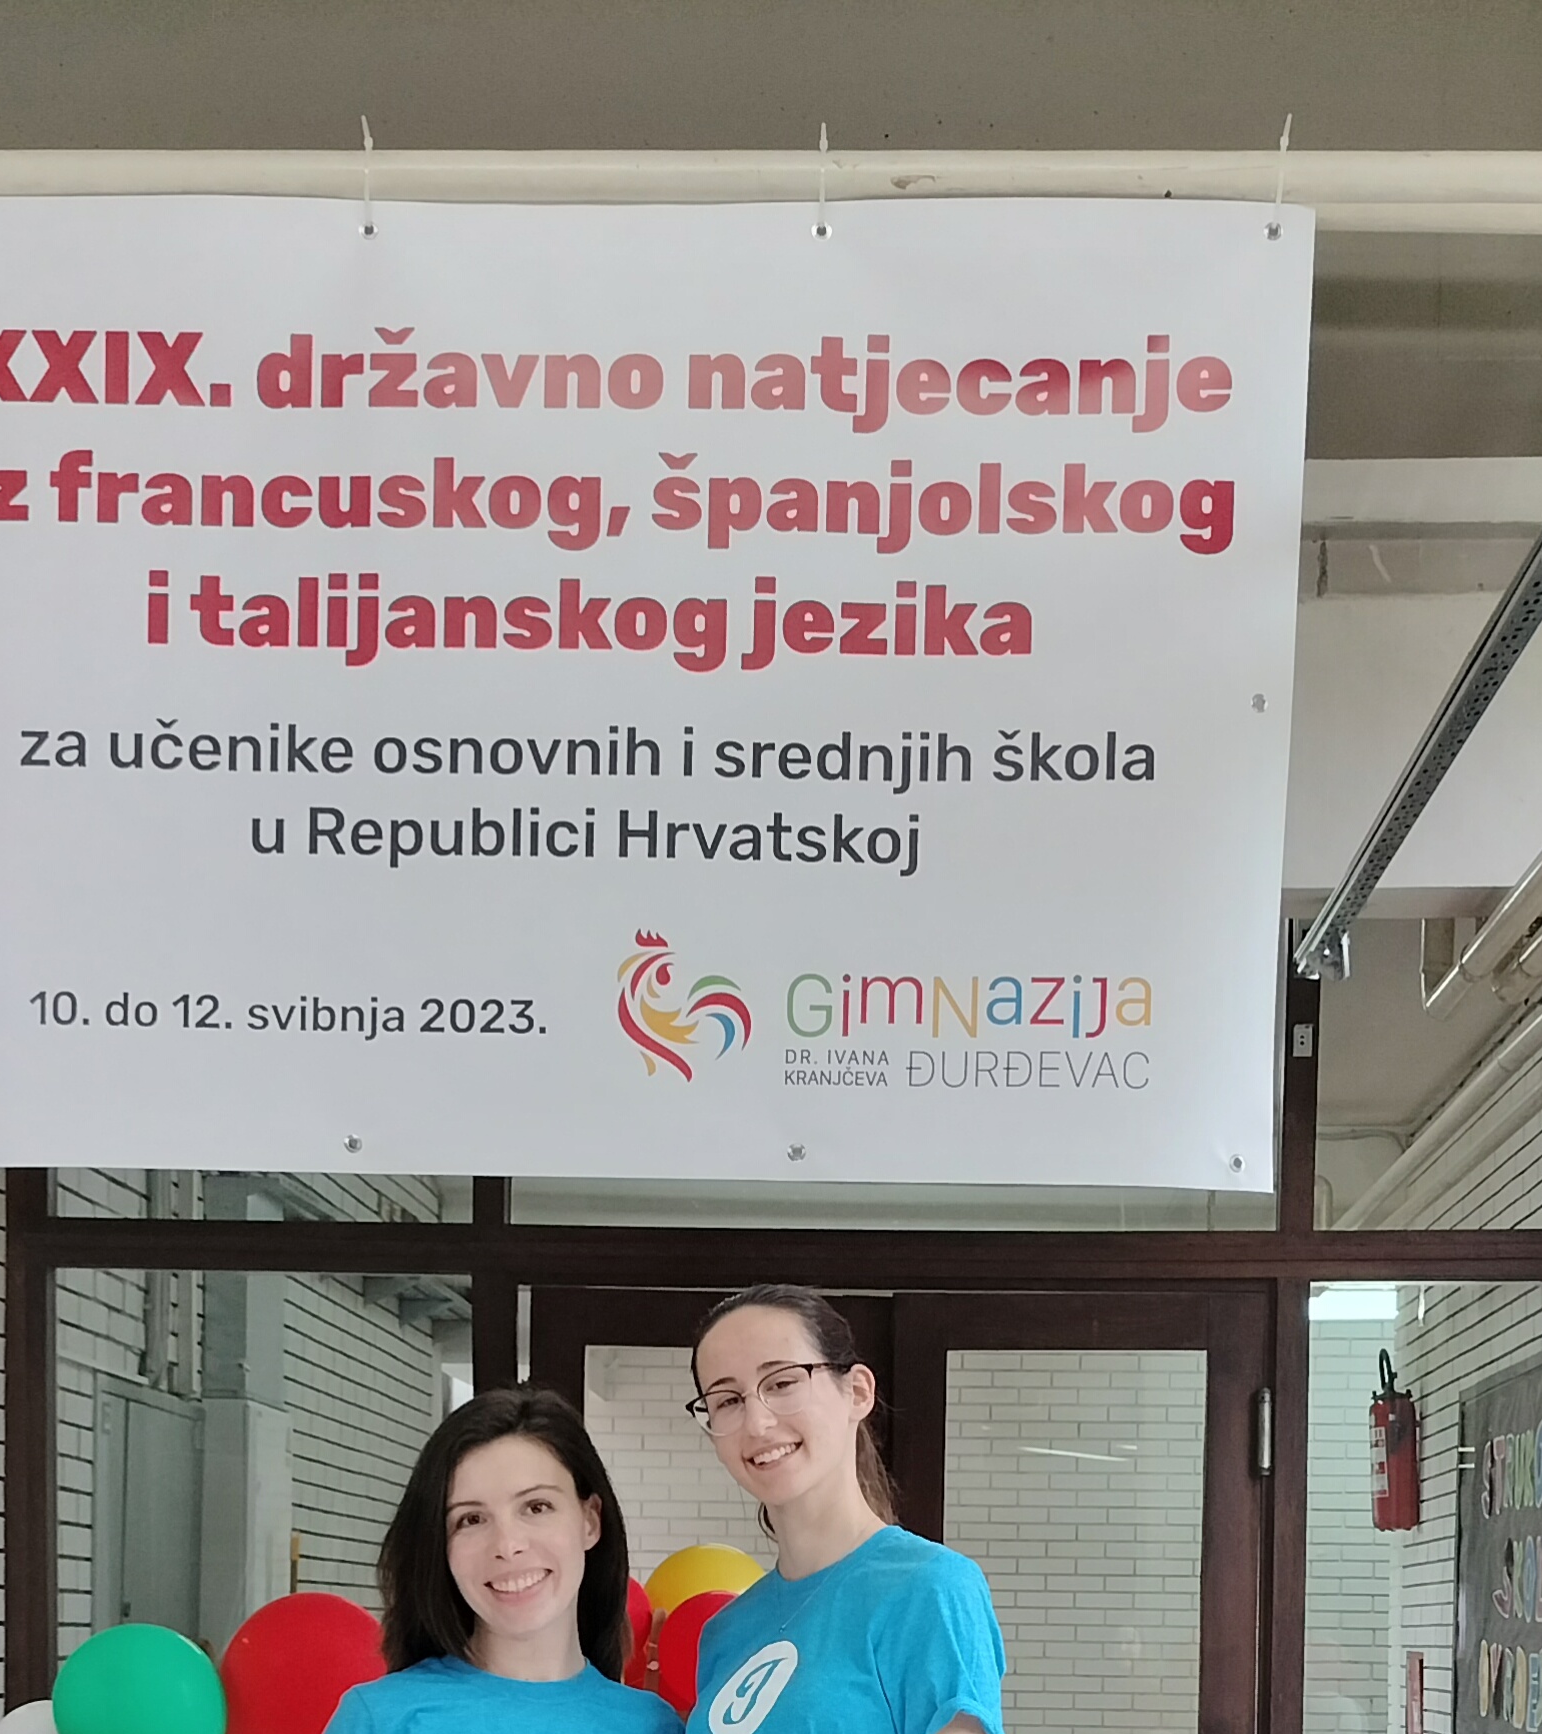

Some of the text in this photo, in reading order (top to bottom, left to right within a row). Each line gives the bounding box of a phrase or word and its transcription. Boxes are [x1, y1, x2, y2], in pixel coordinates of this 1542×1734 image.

[256, 326, 665, 411] državno
[686, 333, 1233, 434] natjecanje
[49, 448, 632, 551] francuskog,
[651, 451, 1235, 555] španjolskog
[147, 569, 1034, 673] i talijanskog jezika
[19, 717, 1156, 795] za učenike osnovnih i srednjih škola
[251, 806, 920, 877] u Republici Hrvatskoj
[29, 990, 548, 1042] 10. do 12. svibnja 2023.
[784, 1048, 890, 1067] DR. IVANA
[784, 1065, 888, 1087] KRANJČEVA
[905, 1050, 1150, 1090] ĐURĐEVAC
